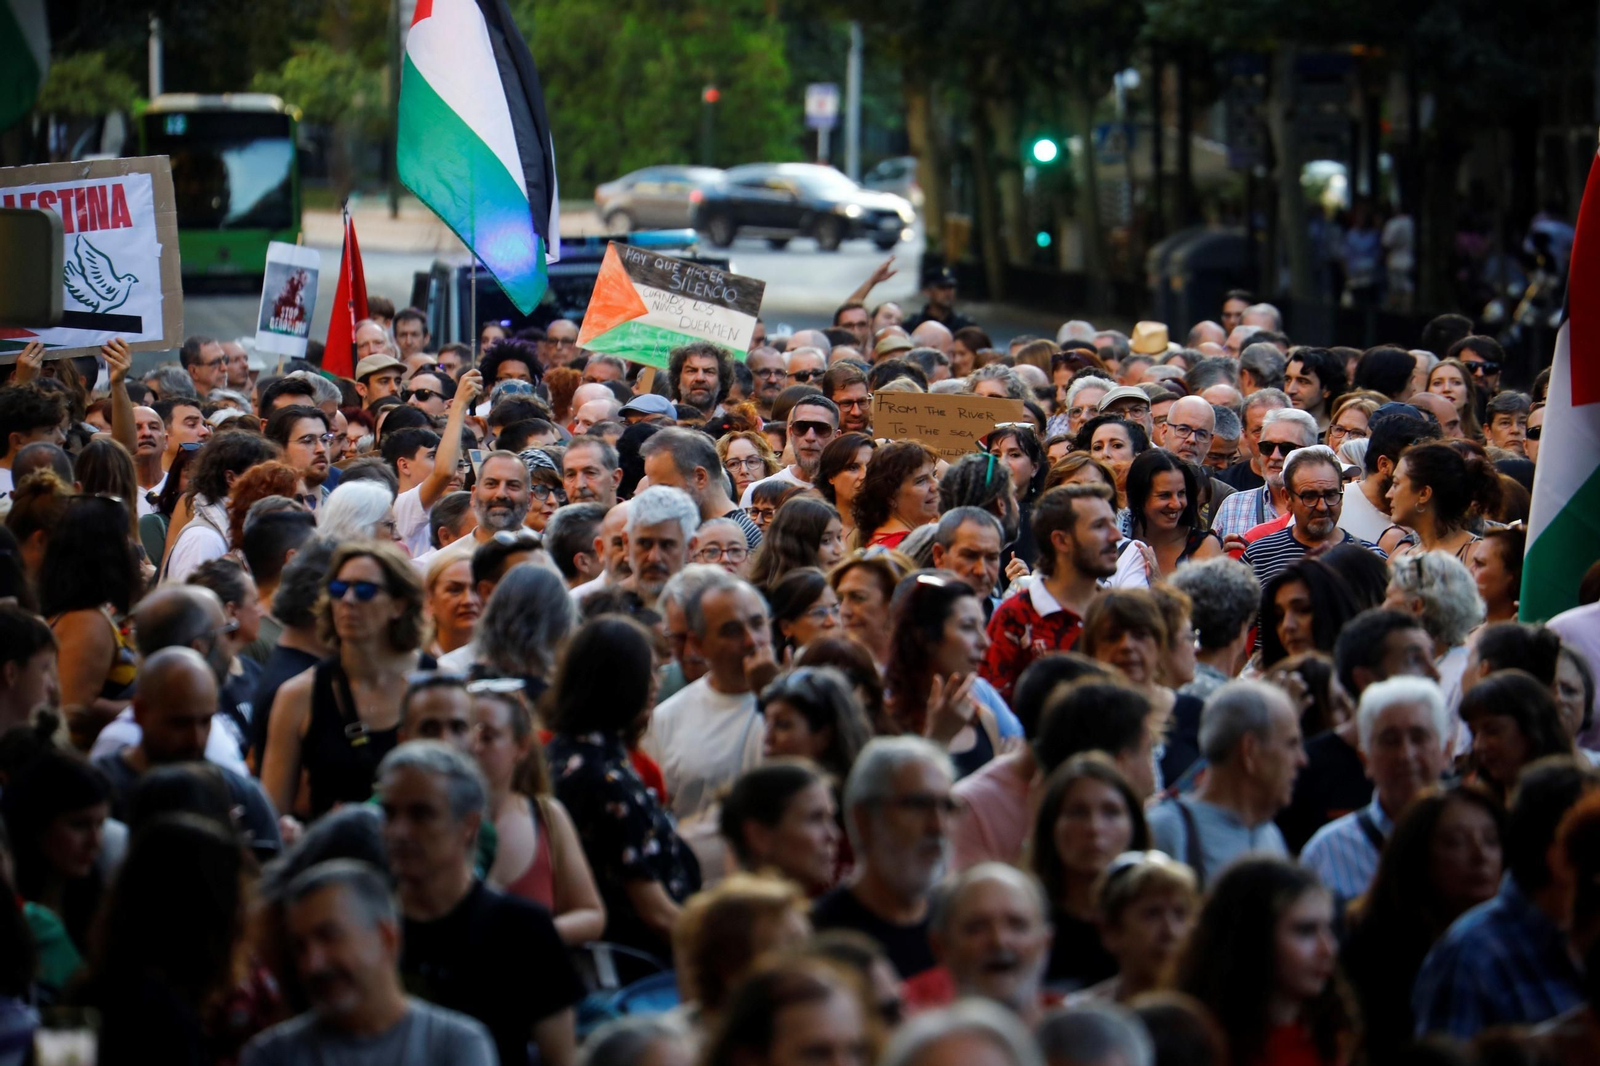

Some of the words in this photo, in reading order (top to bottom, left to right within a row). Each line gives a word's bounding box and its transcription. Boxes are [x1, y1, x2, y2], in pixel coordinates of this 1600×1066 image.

[3, 183, 133, 235] TINA
[625, 247, 647, 266] HAY
[654, 258, 681, 275] QUE
[686, 266, 724, 284] HACER
[643, 287, 685, 306] CUANDO
[692, 300, 715, 316] LOS
[669, 274, 738, 302] SILENCIO
[280, 306, 299, 319] STOP
[679, 316, 740, 341] DUERMEN
[876, 393, 918, 414] FROM
[924, 406, 946, 417] THE
[957, 407, 996, 421] RIVER
[915, 424, 940, 436] THE
[949, 430, 974, 439] SEA
